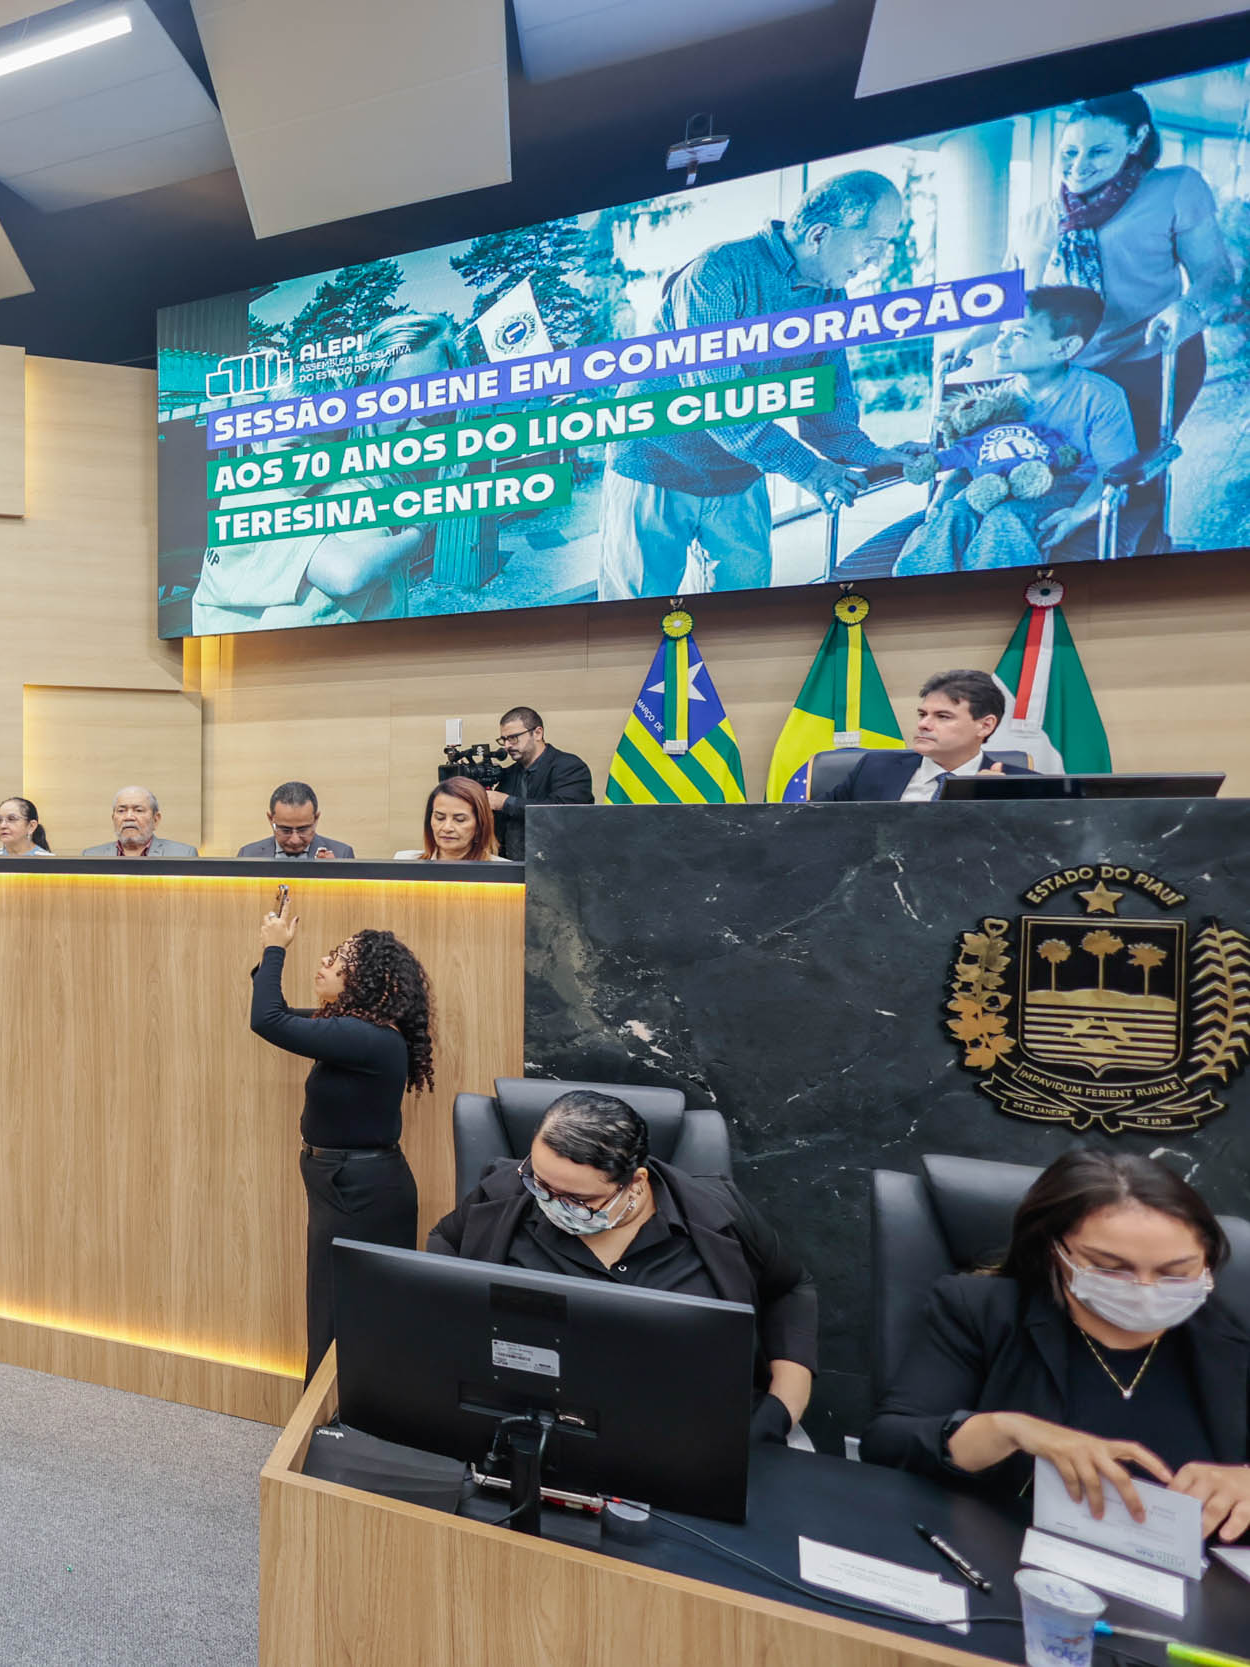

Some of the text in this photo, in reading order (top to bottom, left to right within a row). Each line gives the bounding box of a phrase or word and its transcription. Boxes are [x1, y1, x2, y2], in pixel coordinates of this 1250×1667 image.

[214, 283, 1006, 442] SESSÃO SOLENE EM COMEMORAÇÃO
[300, 334, 363, 362] ALEPI
[355, 344, 412, 364] LEGISLATIVA
[299, 373, 314, 383] DO
[316, 366, 352, 380] ESTADO
[354, 363, 369, 374] DO
[214, 376, 815, 492] AOS 70 ANOS DO LIONS CLUBE
[214, 473, 556, 541] TERESINA-CENTRO
[636, 699, 664, 733] MARÇO DE
[1026, 866, 1185, 906] ESTADO DO PIAUÍ
[1019, 1070, 1179, 1098] IMPAVIDUM FERIENT RUINAE
[1024, 1104, 1035, 1112] DE
[1035, 1107, 1070, 1117] JANEIRO
